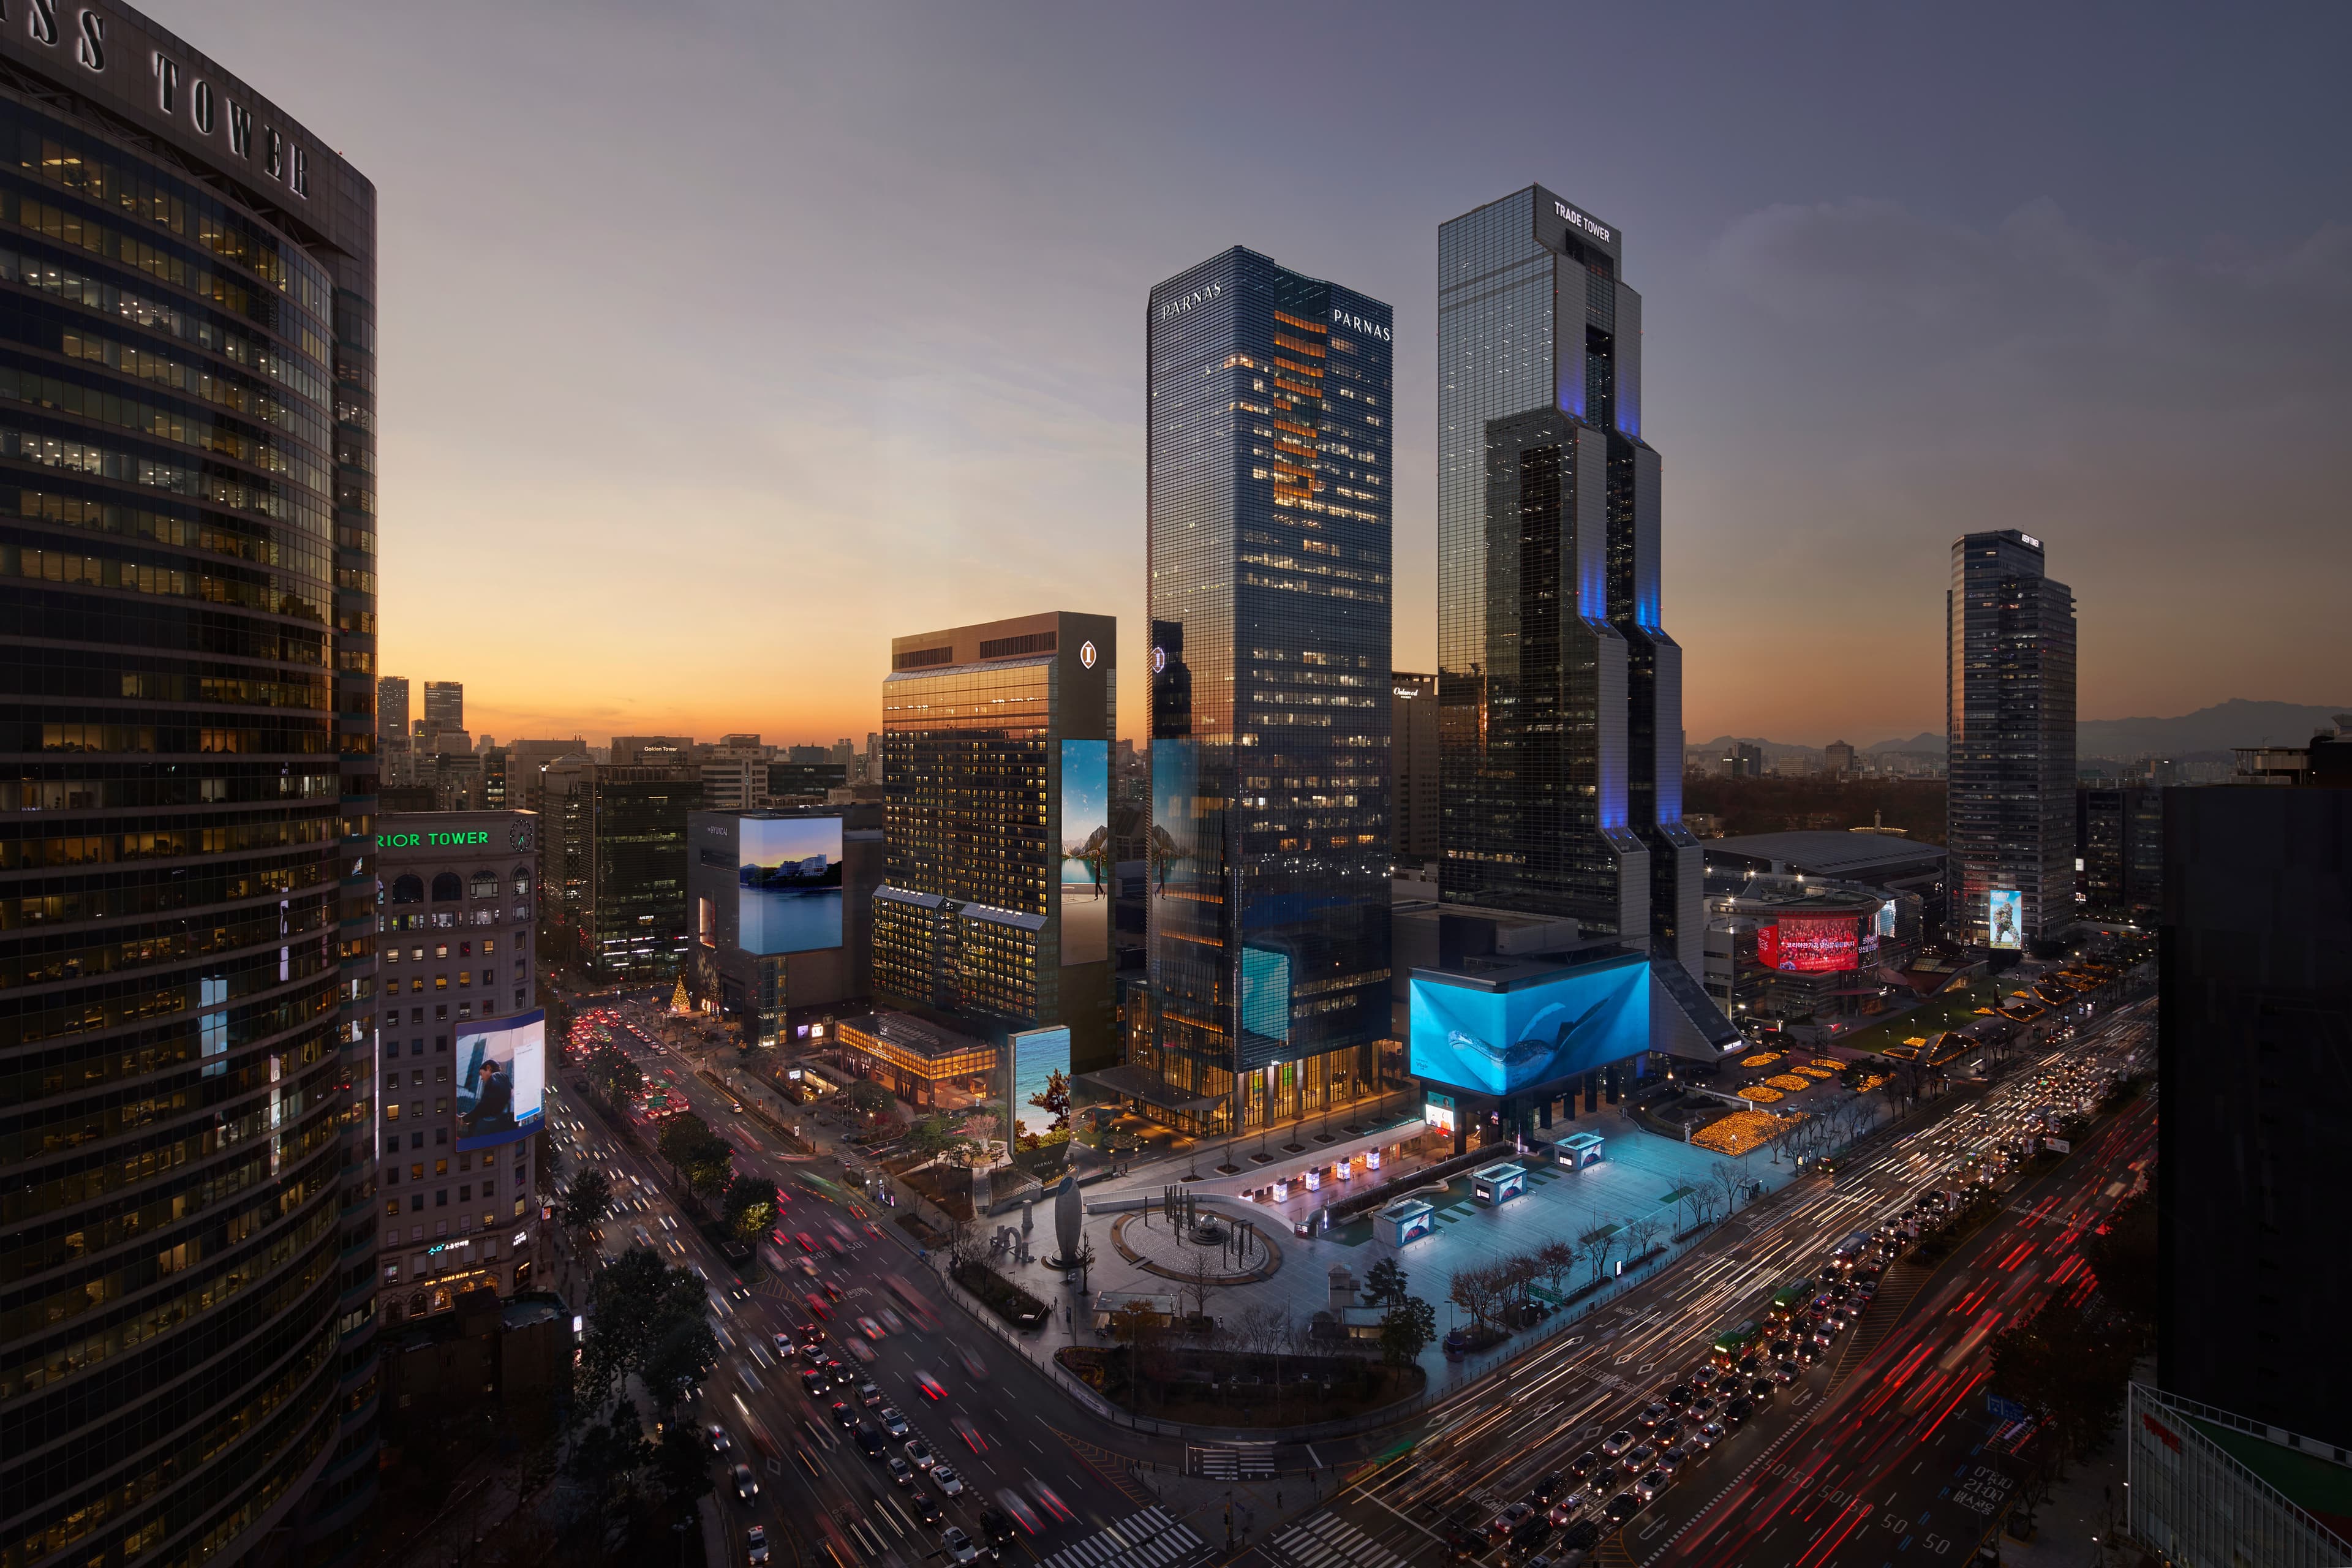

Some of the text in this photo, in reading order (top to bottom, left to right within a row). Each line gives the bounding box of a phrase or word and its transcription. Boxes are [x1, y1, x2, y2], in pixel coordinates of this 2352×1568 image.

[0, 0, 310, 198] SS TOWER
[1555, 202, 1610, 243] TRADE TOWER
[1163, 281, 1223, 320] PARNAS
[1334, 309, 1390, 341] PARNAS
[428, 832, 488, 845] TOWER
[711, 826, 728, 836] HYUNDAI
[809, 1251, 825, 1260] 50
[846, 1241, 862, 1250] 50
[1818, 1485, 1845, 1504] 50
[1953, 1490, 1995, 1515] 버스전용
[1880, 1513, 1909, 1534] 50
[1922, 1532, 1951, 1554] 50
